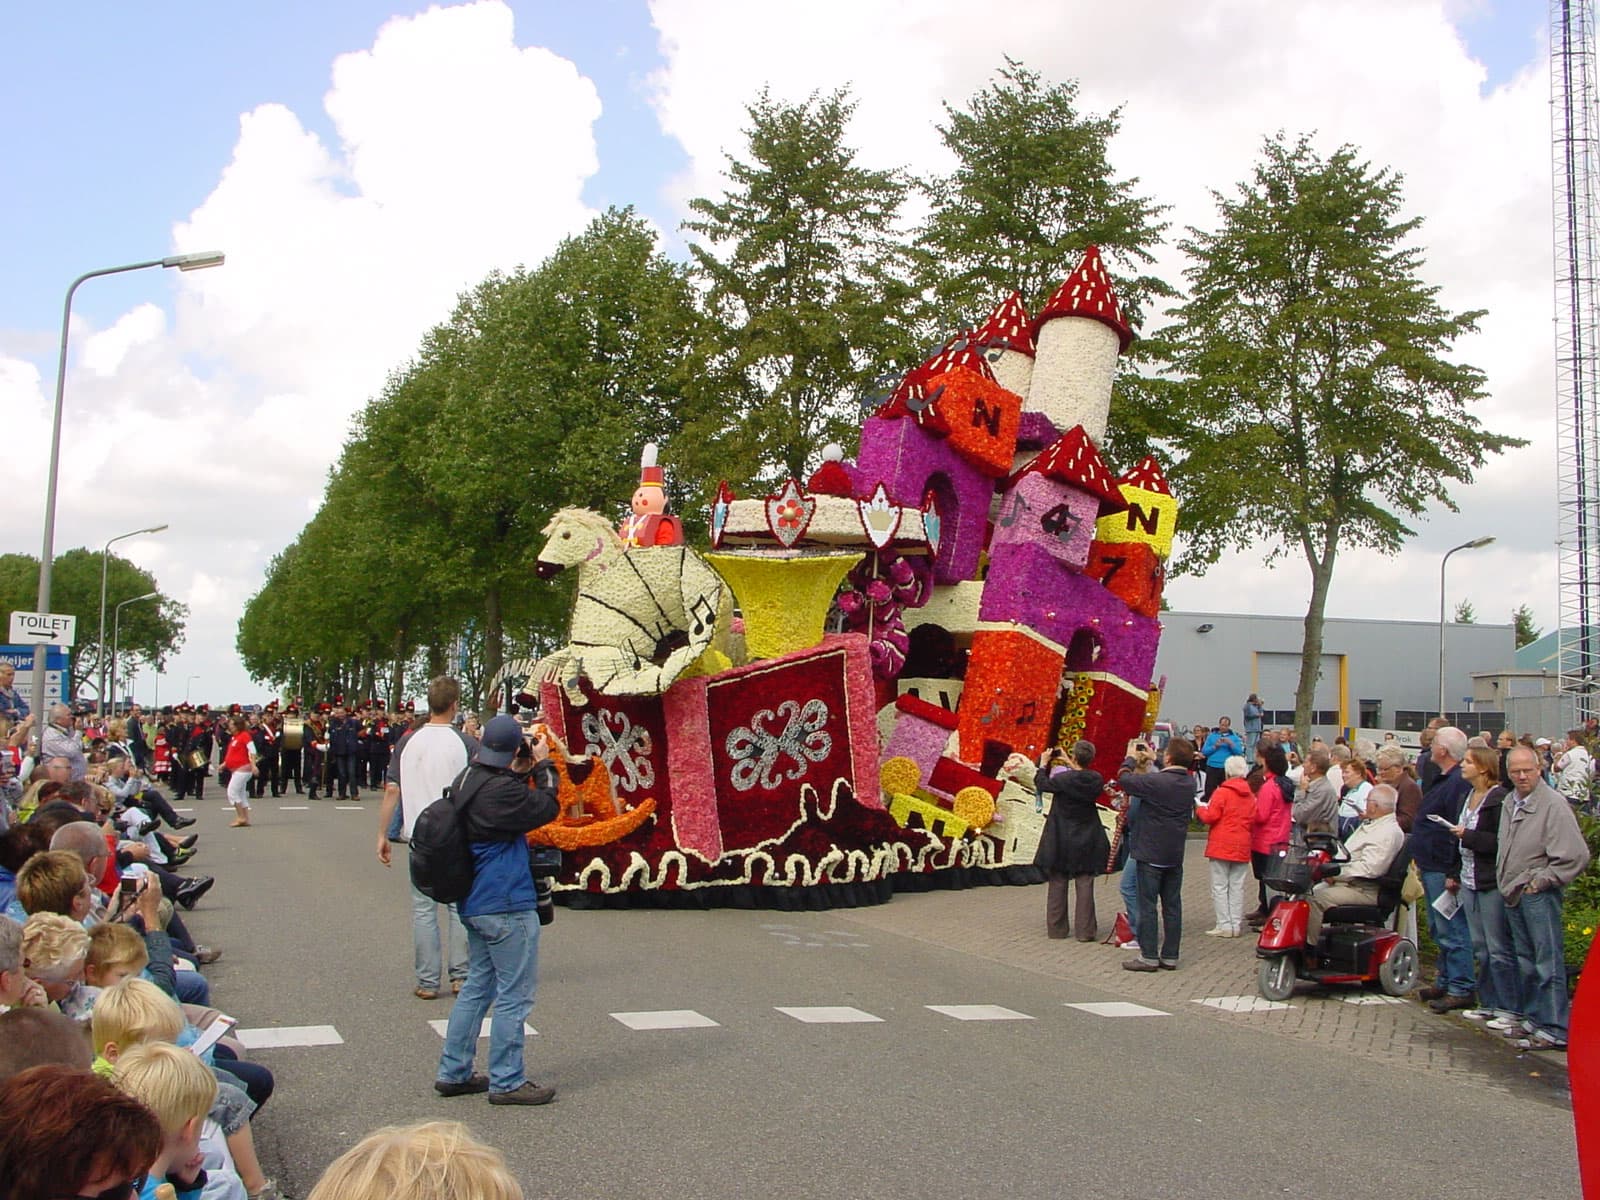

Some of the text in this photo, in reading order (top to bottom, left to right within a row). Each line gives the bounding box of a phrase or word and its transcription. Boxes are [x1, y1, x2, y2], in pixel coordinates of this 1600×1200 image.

[971, 397, 1001, 437] N
[1127, 502, 1160, 535] N
[1101, 556, 1128, 587] 7
[18, 615, 70, 630] TOILET
